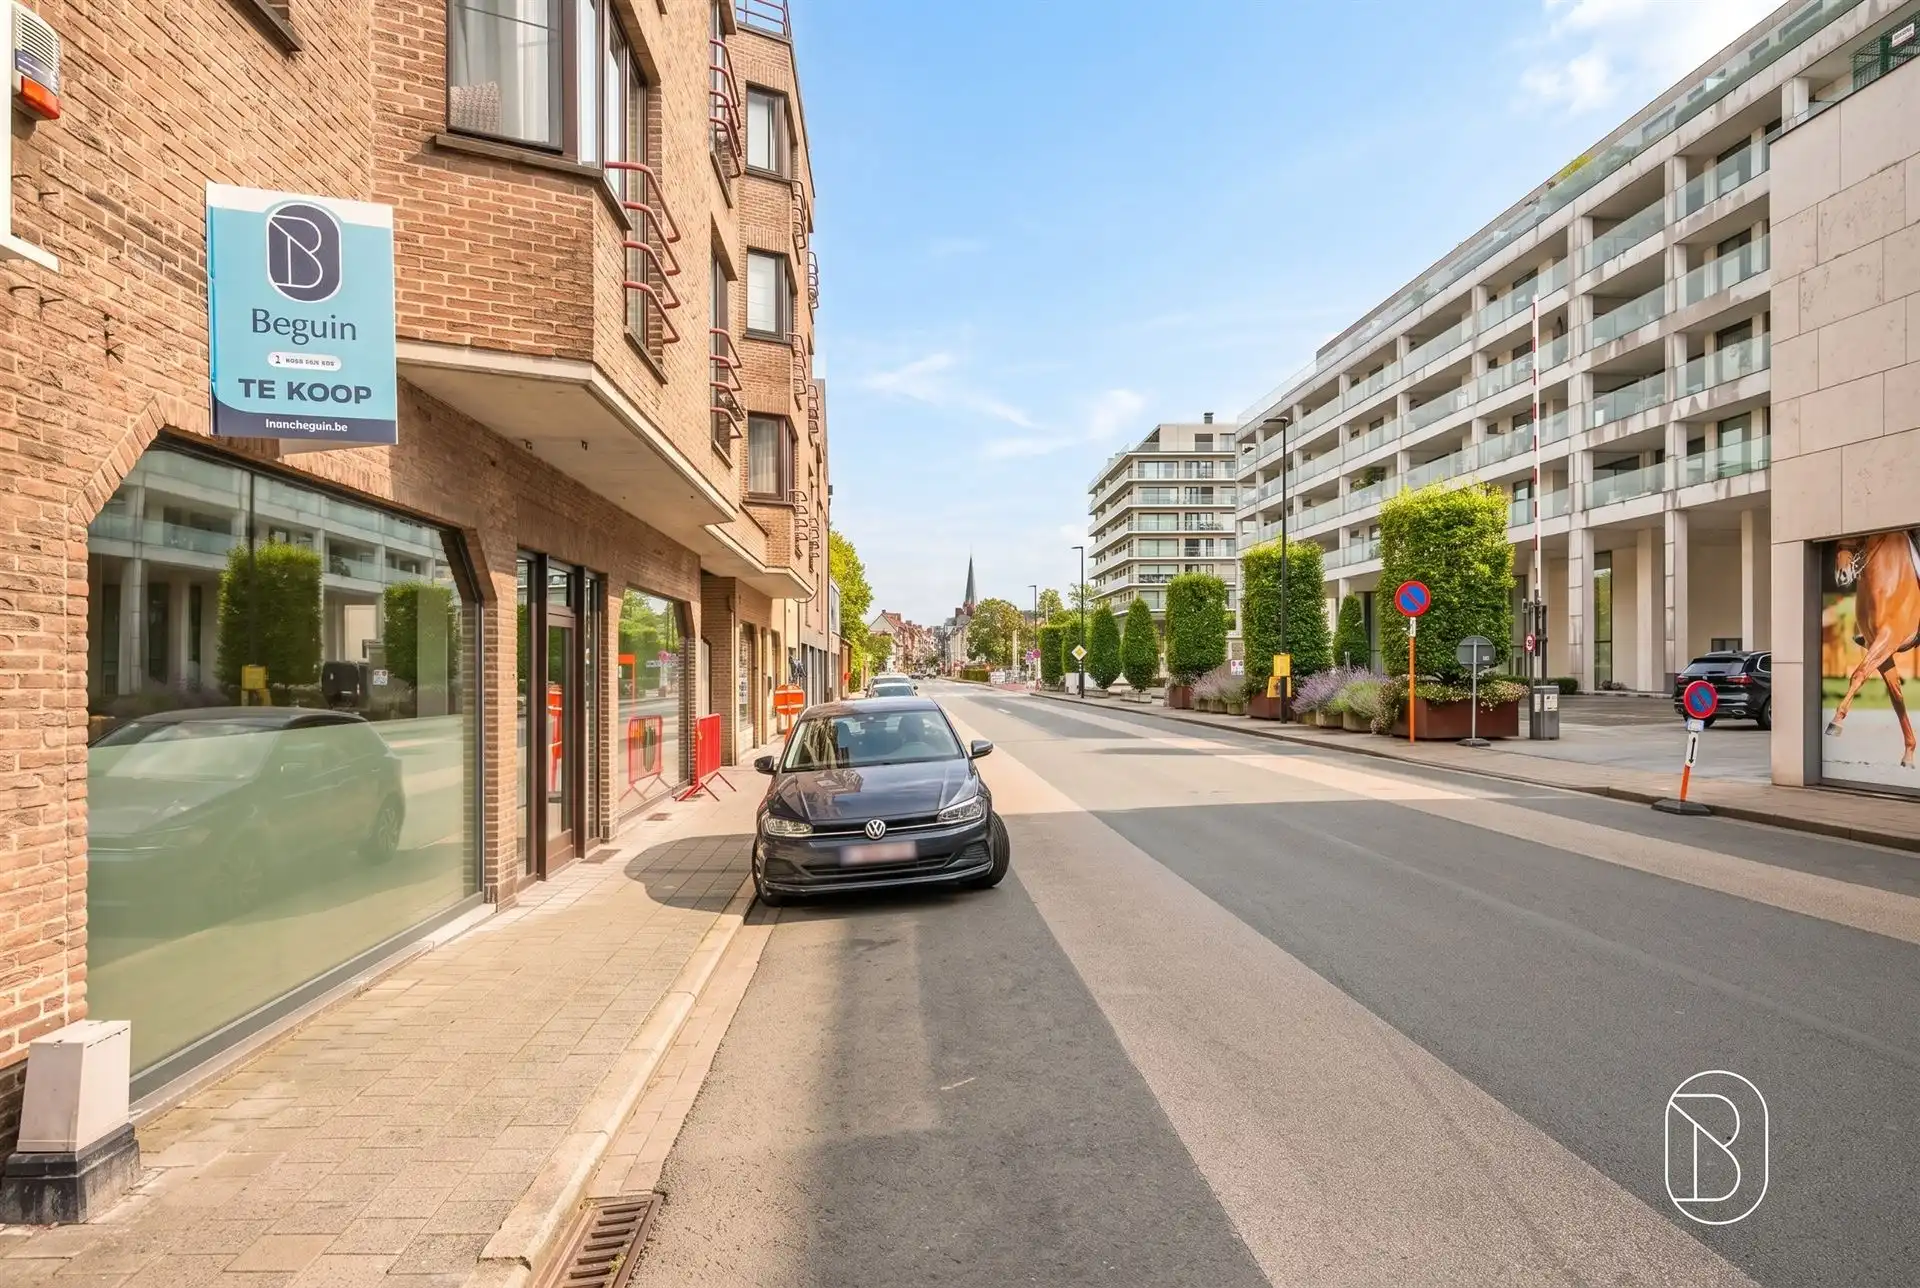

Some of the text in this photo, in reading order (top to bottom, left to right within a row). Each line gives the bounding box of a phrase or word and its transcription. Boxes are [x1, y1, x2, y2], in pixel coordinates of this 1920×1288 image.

[251, 308, 357, 345] Beguin
[238, 378, 372, 404] TE KOOP
